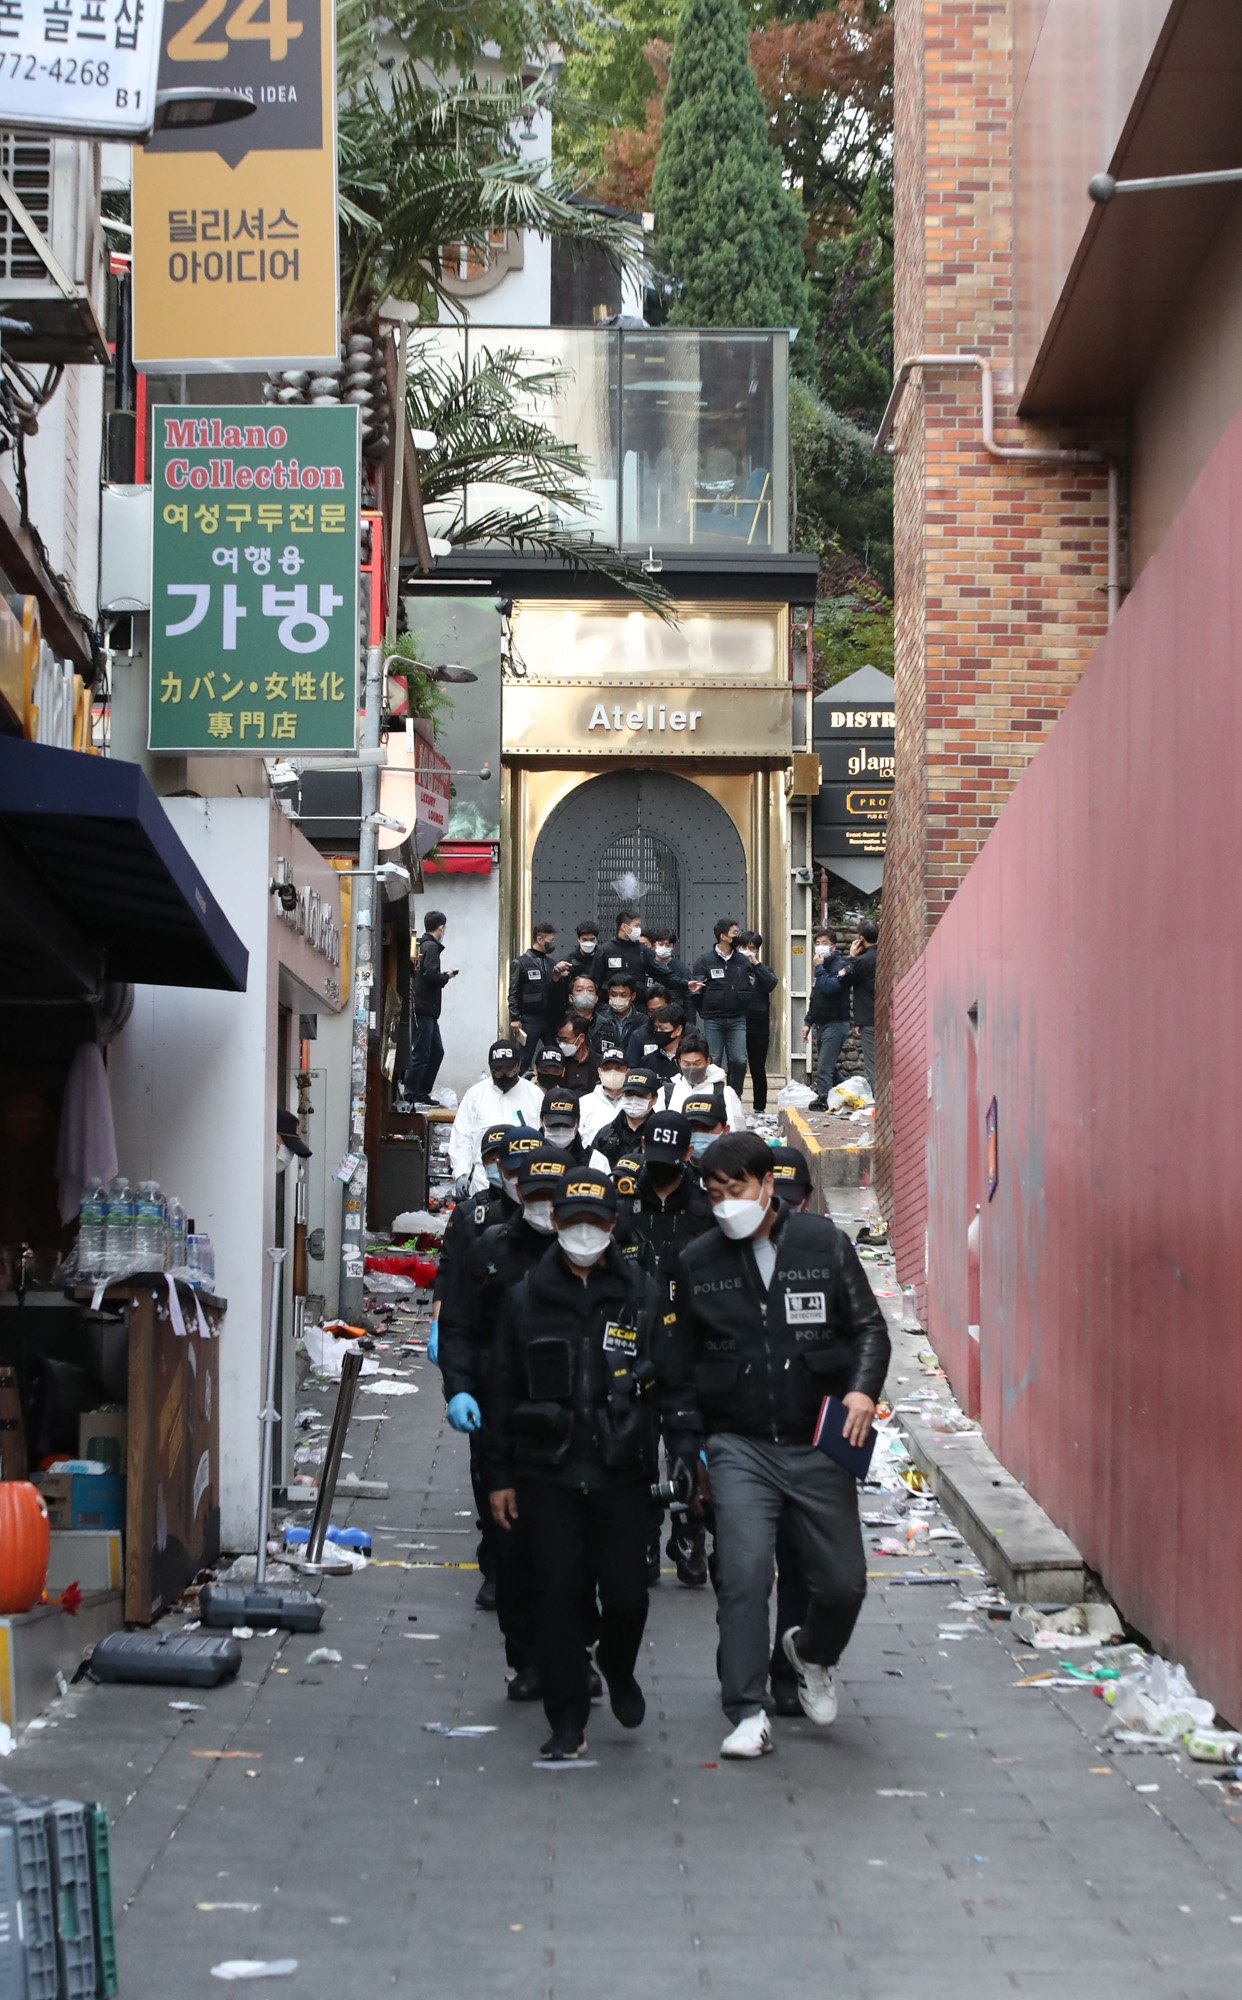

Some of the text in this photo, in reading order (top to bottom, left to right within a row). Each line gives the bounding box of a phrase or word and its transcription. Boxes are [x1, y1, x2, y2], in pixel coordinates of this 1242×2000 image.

[115, 88, 141, 109] B1
[260, 86, 298, 103] IDEA
[168, 208, 300, 243] 딜리셔스
[168, 249, 300, 284] 아이디어
[164, 418, 288, 448] Milano
[165, 459, 344, 490] Collection
[163, 504, 346, 534] 여성구두전문
[212, 546, 305, 575] 여행용
[165, 584, 344, 654] 가방
[588, 704, 703, 732] Atelier
[492, 1048, 513, 1060] NFS
[542, 1051, 562, 1062] NFS
[603, 1049, 624, 1060] NFS
[627, 1074, 647, 1084] KCSI
[550, 1101, 574, 1110] KCSI
[685, 1101, 712, 1111] KCSI
[488, 1132, 505, 1142] KC
[653, 1127, 678, 1145] CSI
[508, 1139, 543, 1152] KCSI
[529, 1162, 566, 1175] KCSI
[617, 1159, 640, 1171] KCSI
[772, 1165, 797, 1178] CSI
[566, 1183, 606, 1198] KCSI
[778, 1268, 831, 1281] POLICE
[693, 1277, 743, 1295] POLICE
[789, 1311, 823, 1321] DETECTIVE
[607, 1327, 637, 1342] KCSI
[795, 1329, 834, 1342] POLIC
[704, 1339, 736, 1351] OLICE
